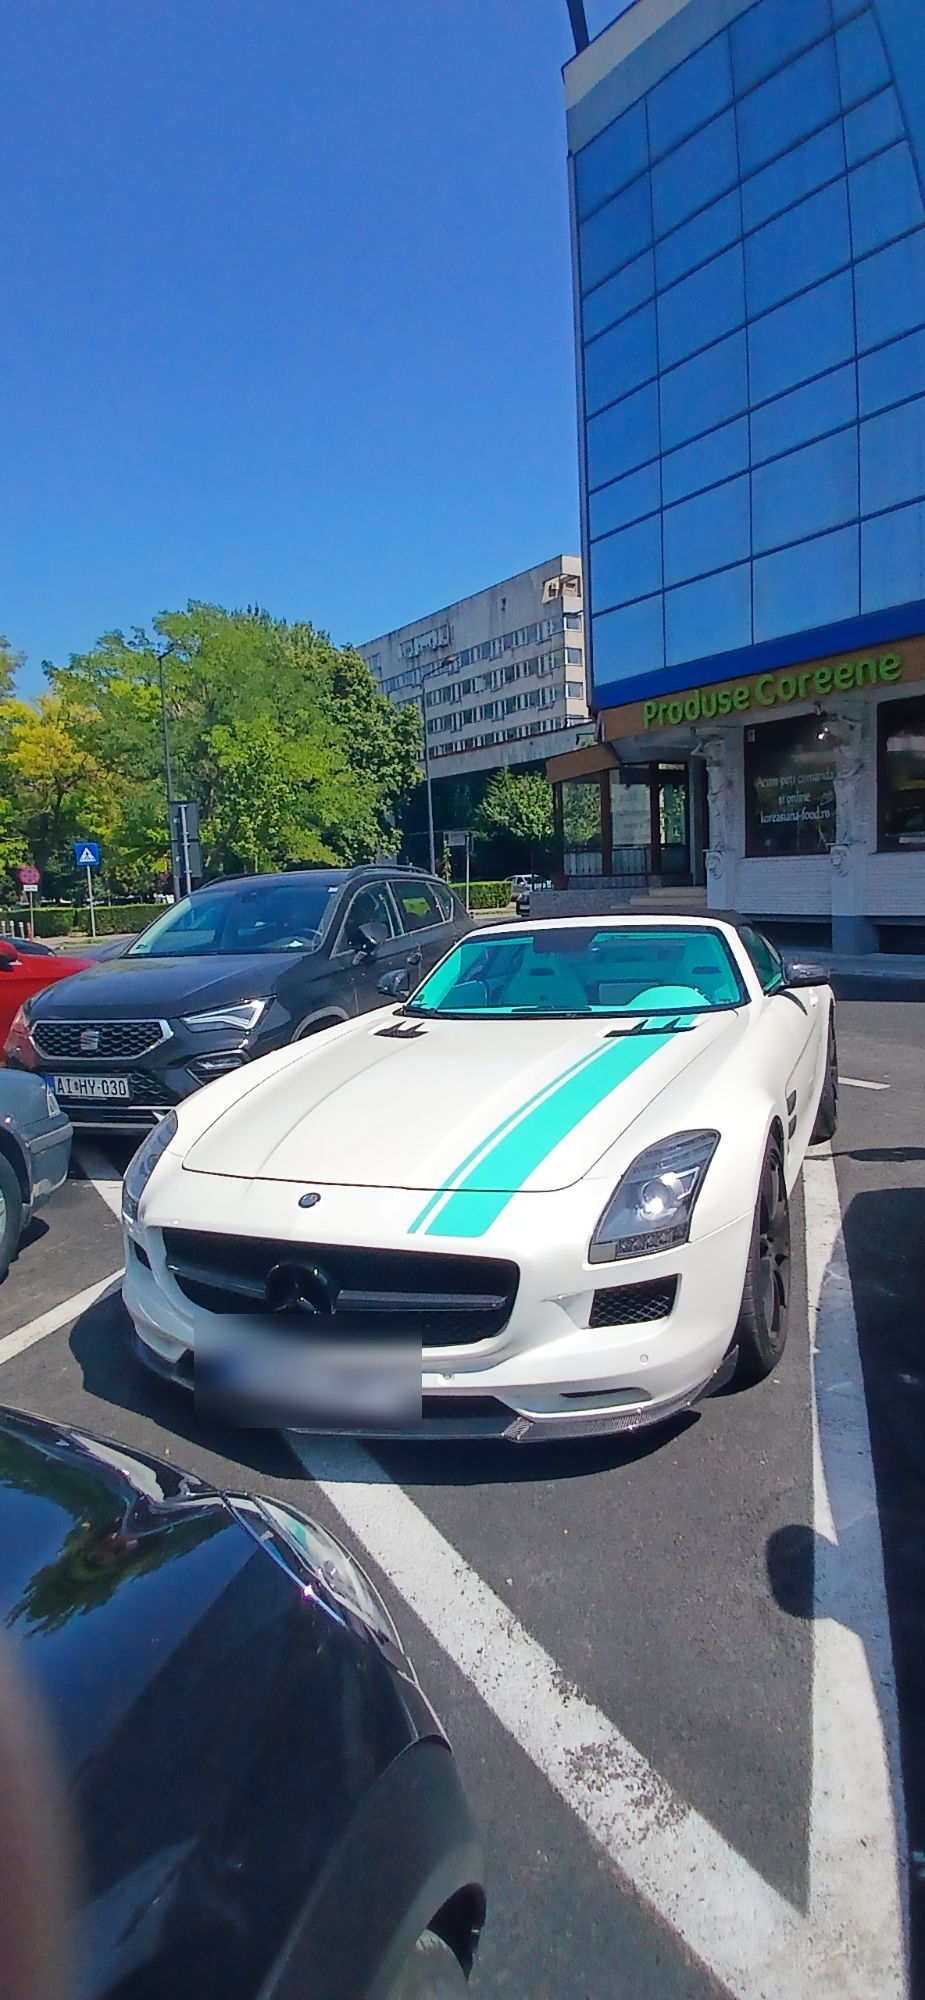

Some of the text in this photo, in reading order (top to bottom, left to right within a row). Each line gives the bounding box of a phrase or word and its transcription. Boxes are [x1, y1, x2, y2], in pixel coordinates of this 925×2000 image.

[643, 652, 902, 729] Produse Coreene
[787, 789, 810, 804] online
[79, 1079, 127, 1096] HY-030
